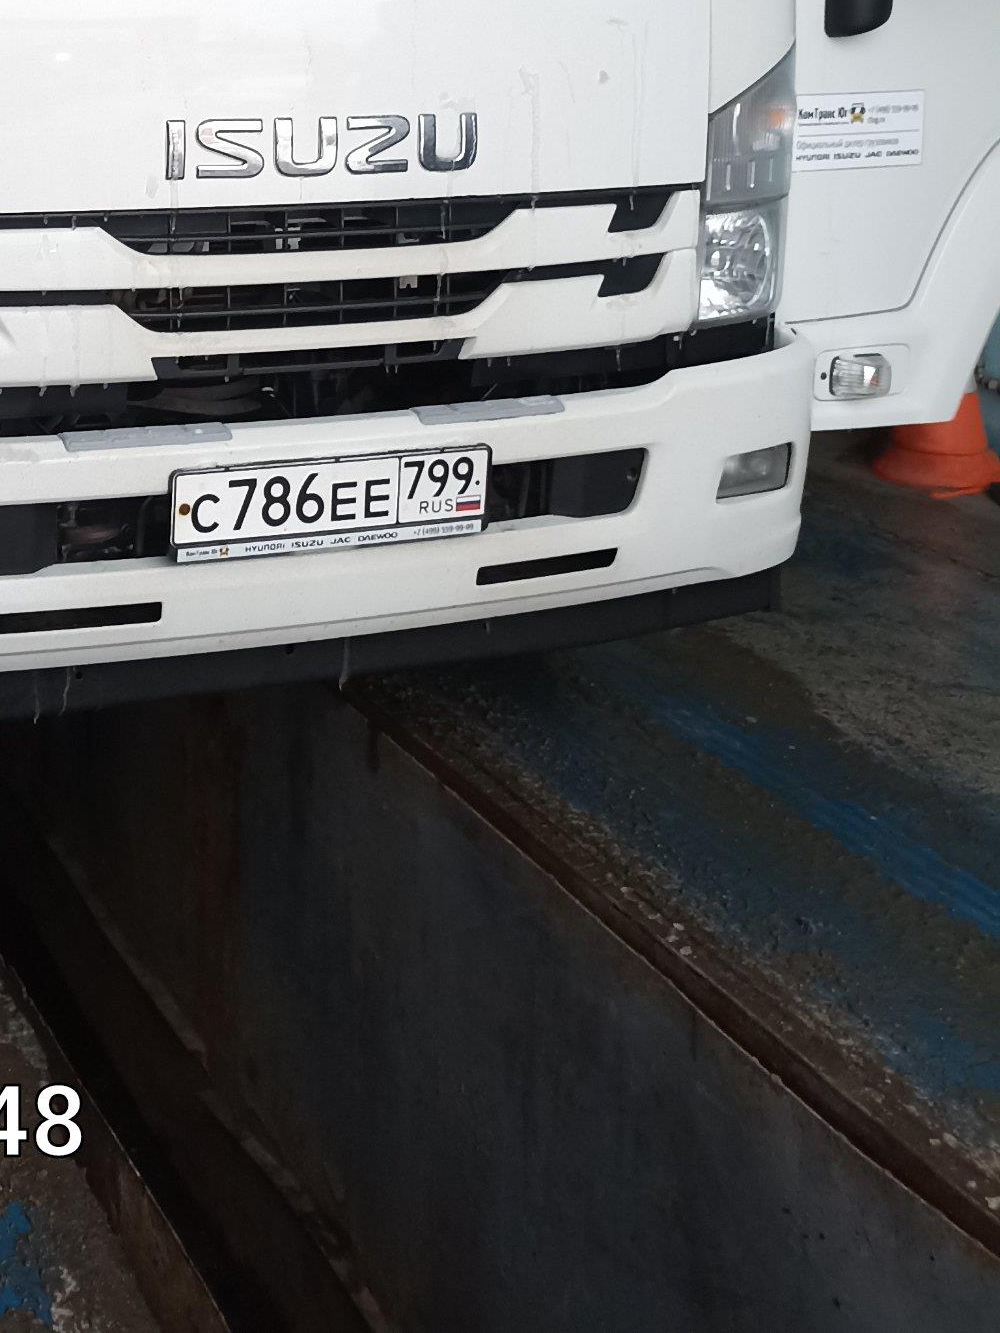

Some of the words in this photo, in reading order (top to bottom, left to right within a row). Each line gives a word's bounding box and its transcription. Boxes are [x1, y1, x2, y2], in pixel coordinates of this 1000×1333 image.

[164, 112, 478, 181] ISUZU
[796, 153, 830, 162] HYUNDAI
[833, 152, 861, 160] ISUZU
[865, 150, 883, 158] JAC
[886, 149, 920, 157] DAEWOO
[403, 456, 476, 500] 799
[418, 498, 454, 515] RUS
[245, 542, 286, 553] HYUNDAI
[291, 539, 324, 549] ISUZU
[330, 536, 351, 545] JAC
[357, 531, 399, 543] DAEWOO
